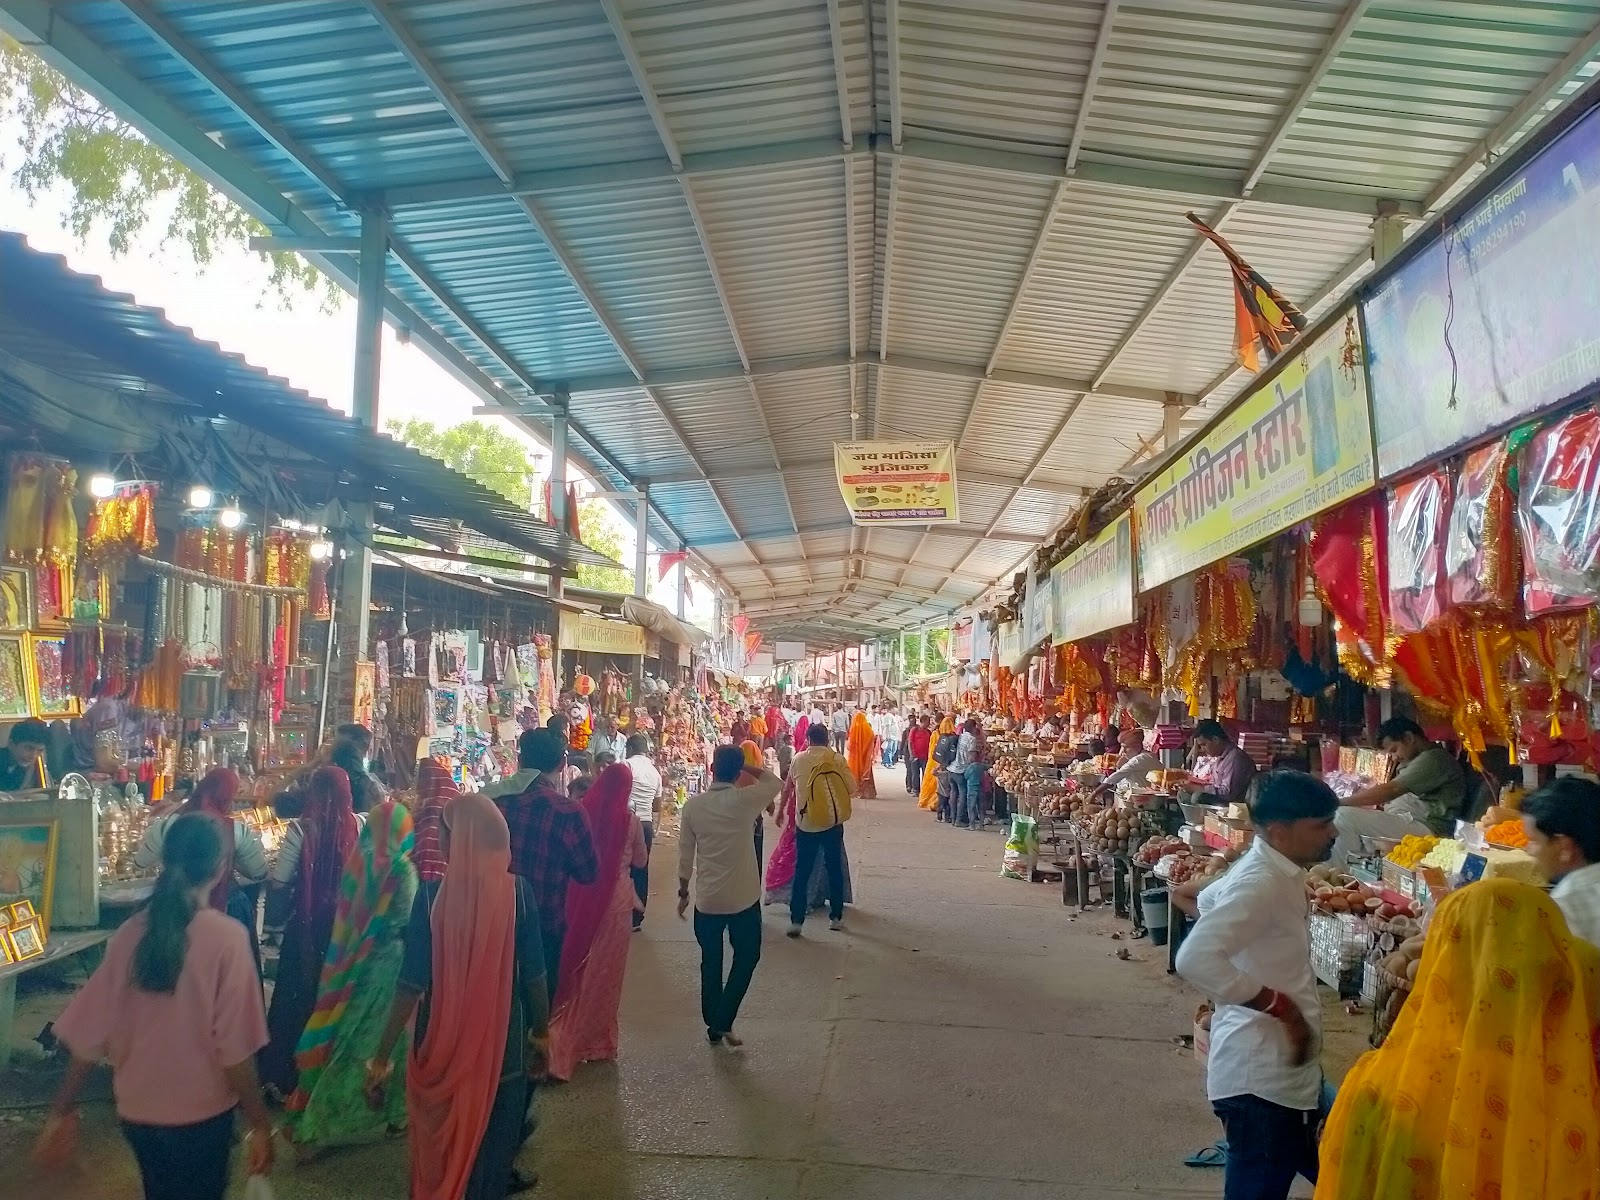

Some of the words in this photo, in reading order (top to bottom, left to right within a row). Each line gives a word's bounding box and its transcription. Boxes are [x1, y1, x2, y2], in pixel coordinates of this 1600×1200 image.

[1475, 199, 1492, 225] भाई
[1493, 178, 1526, 215] सिवाणा
[1470, 210, 1526, 261] 9928294190
[860, 462, 930, 474] म्युजिकल
[881, 450, 938, 460] माजिसा
[1180, 430, 1250, 530] प्रोविजन
[1251, 382, 1307, 480] स्टोर
[1339, 462, 1364, 492] उपलब्ध
